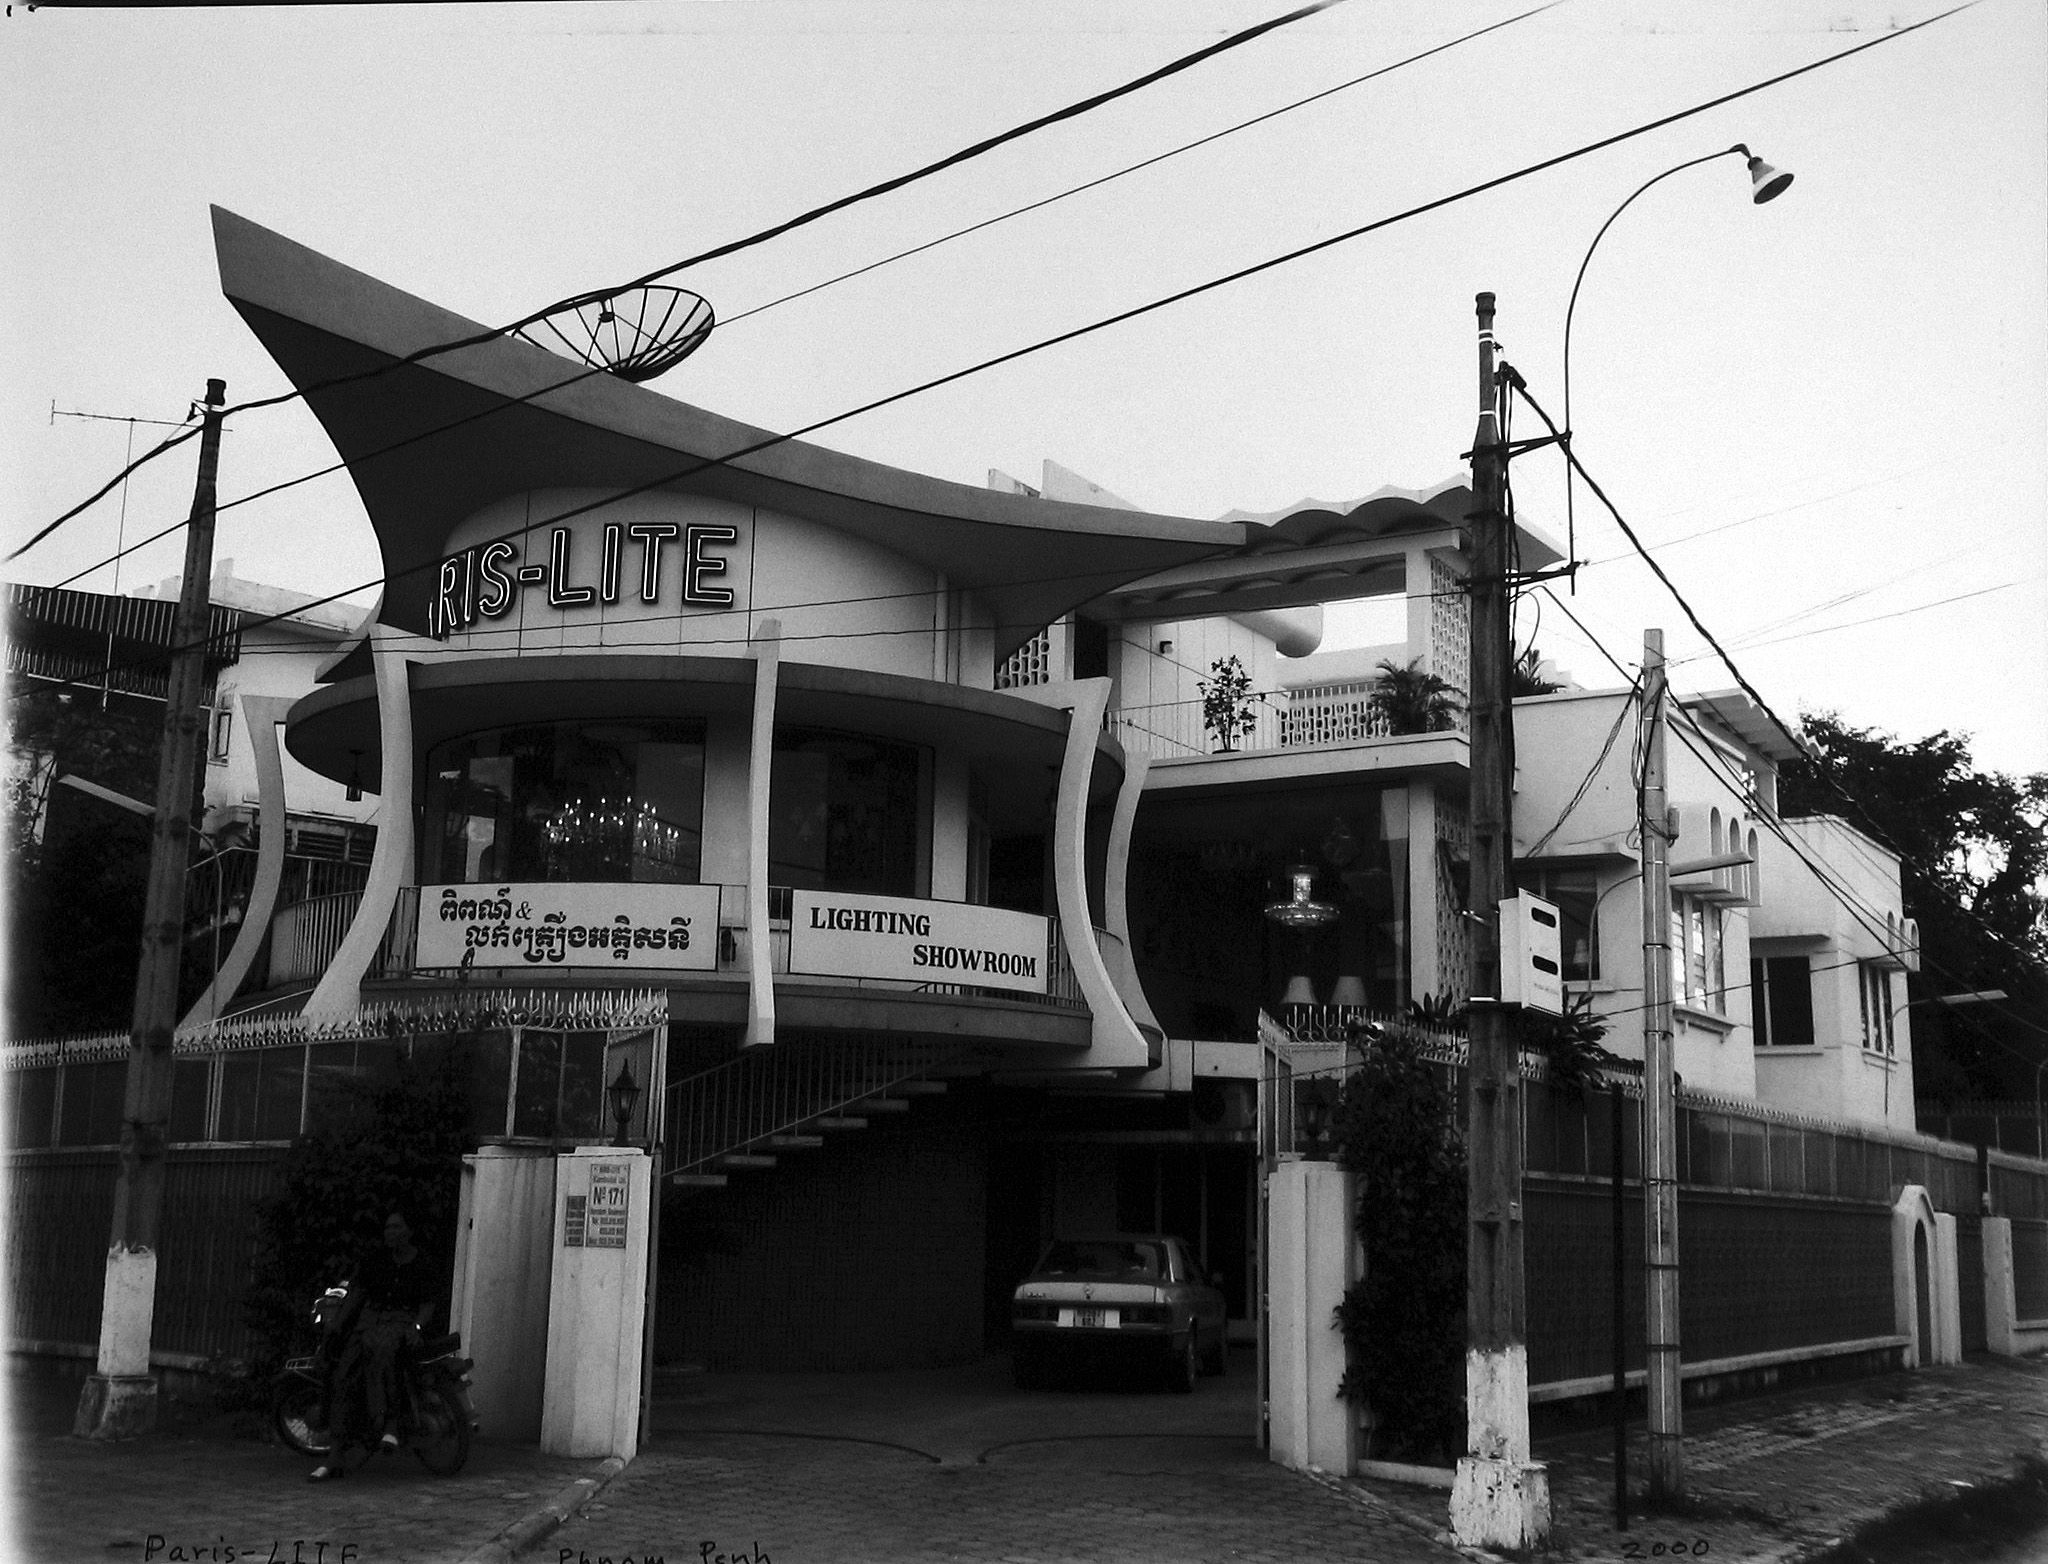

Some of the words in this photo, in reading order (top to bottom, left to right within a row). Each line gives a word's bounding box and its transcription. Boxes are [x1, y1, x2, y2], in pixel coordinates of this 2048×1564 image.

[428, 521, 738, 642] RIS-LITE
[516, 901, 532, 920] &
[810, 907, 931, 937] LIGHTING
[912, 944, 1037, 978] SHOWROOM
[608, 1187, 624, 1205] 171
